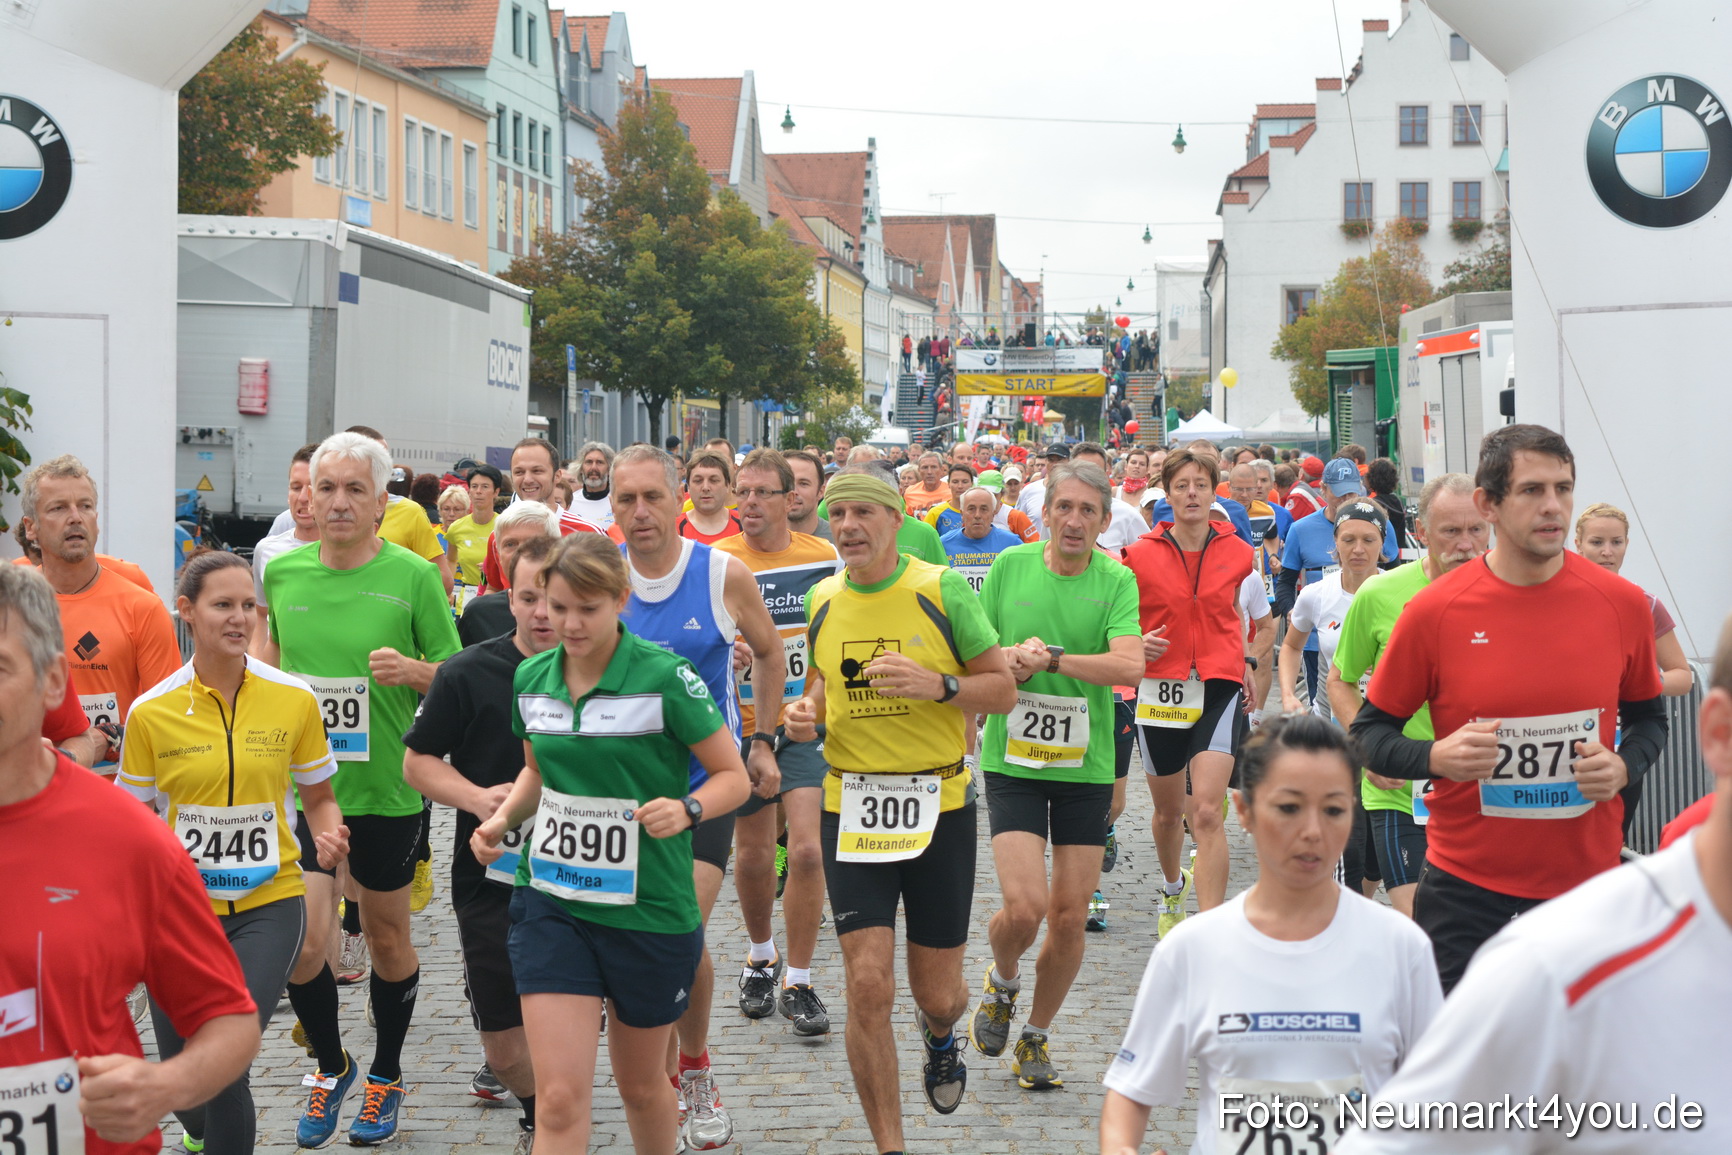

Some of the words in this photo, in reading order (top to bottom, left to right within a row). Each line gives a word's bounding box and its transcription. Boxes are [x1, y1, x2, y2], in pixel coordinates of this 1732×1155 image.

[1598, 78, 1725, 131] BMW
[487, 338, 522, 391] BOCK
[1005, 379, 1056, 391] START
[763, 592, 805, 608] sche
[1159, 681, 1184, 705] 86
[322, 698, 360, 729] 39
[850, 705, 909, 714] APOTHEKE
[1038, 702, 1078, 712] Neumarkt
[1149, 708, 1188, 719] Roswitha
[1022, 711, 1072, 743] 281
[1495, 728, 1520, 738] RTL
[1522, 723, 1579, 738] Neumarkt
[1027, 746, 1063, 762] Jürgen
[844, 783, 875, 792] PARTL
[877, 784, 923, 793] Neumarkt
[1513, 789, 1570, 807] Philipp
[541, 797, 562, 815] PARTL
[563, 806, 618, 819] Neumarkt
[860, 796, 920, 829] 300
[178, 812, 208, 825] PARTL
[210, 814, 259, 826] Neumarkt
[184, 827, 269, 864] 2446
[539, 816, 627, 864] 2690
[855, 837, 917, 850] Alexander
[201, 873, 249, 887] Sabine
[555, 866, 603, 888] Andrea
[1258, 1015, 1357, 1029] BÜSCHEL
[0, 1081, 48, 1100] markt
[0, 1102, 59, 1155] 31
